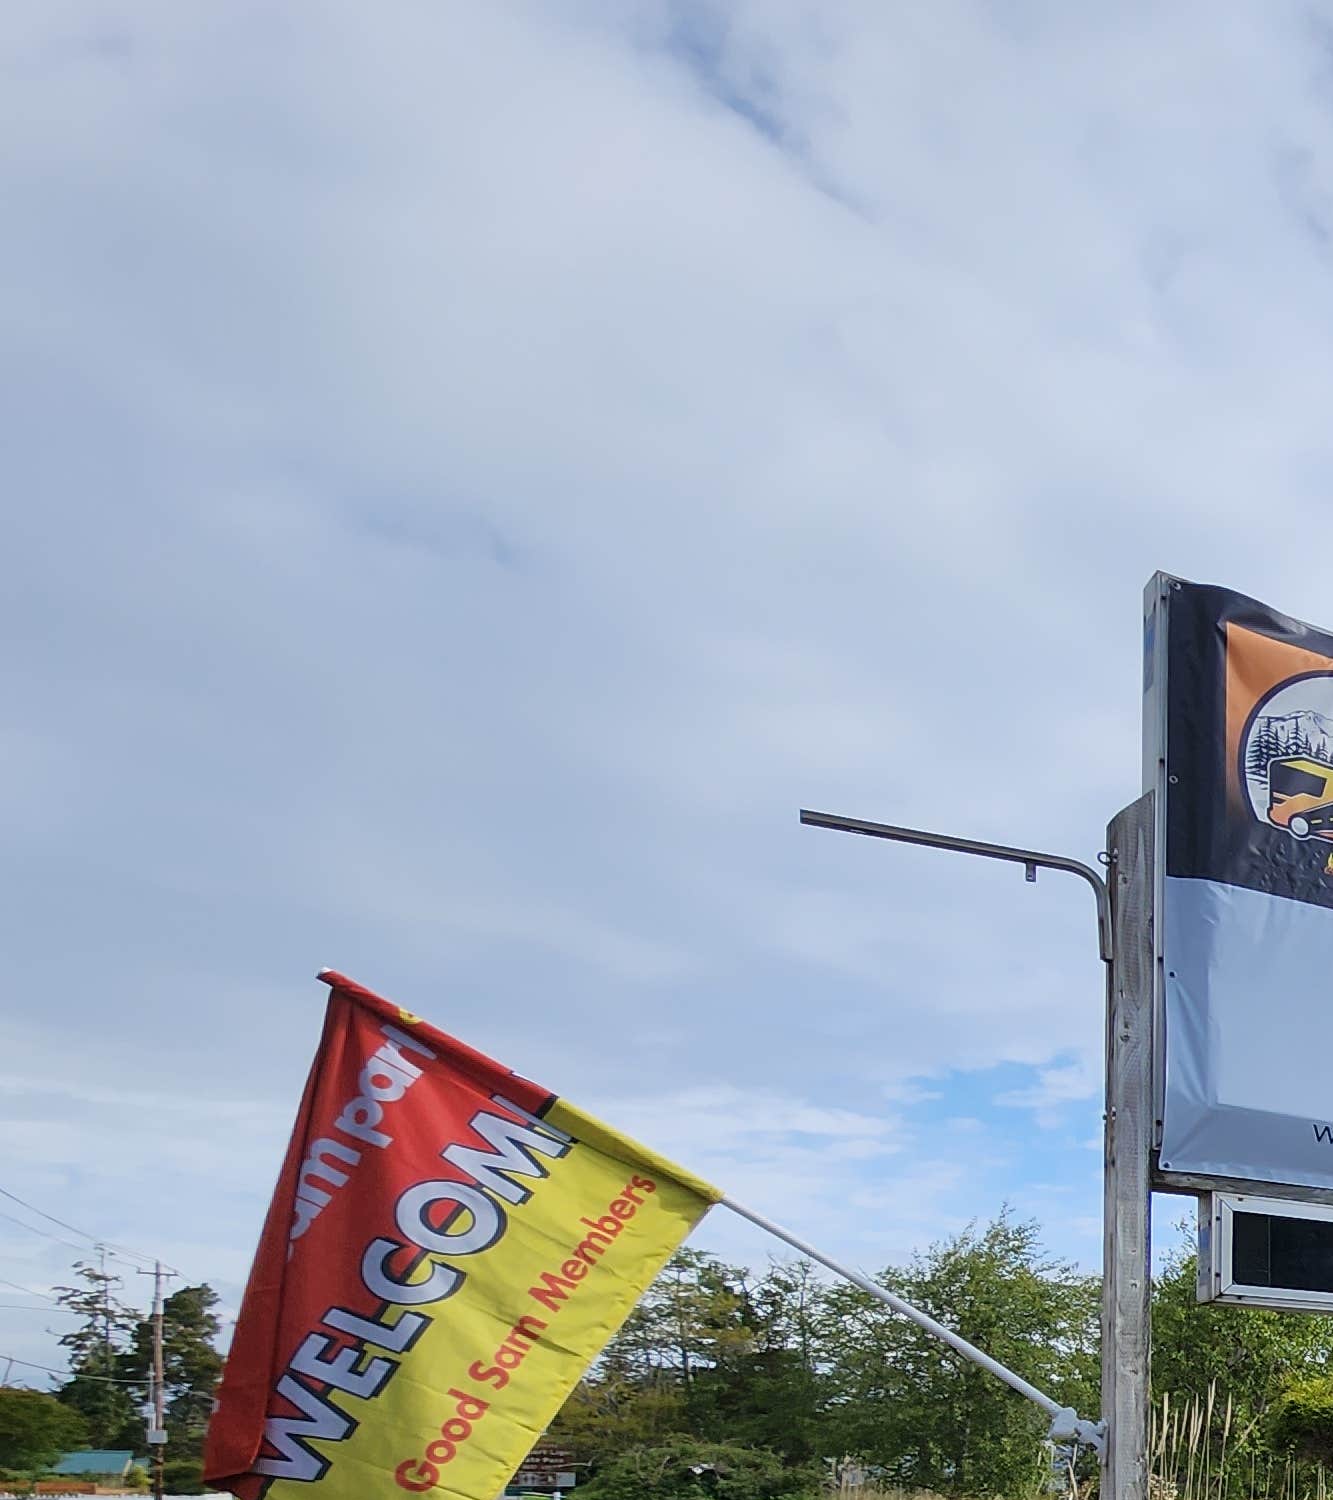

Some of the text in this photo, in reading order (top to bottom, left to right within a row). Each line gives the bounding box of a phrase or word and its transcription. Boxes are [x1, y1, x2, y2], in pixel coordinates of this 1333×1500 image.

[252, 1094, 578, 1483] WELCOM
[393, 1387, 491, 1494] Good
[468, 1313, 548, 1391] Sam
[528, 1172, 658, 1315] Members
